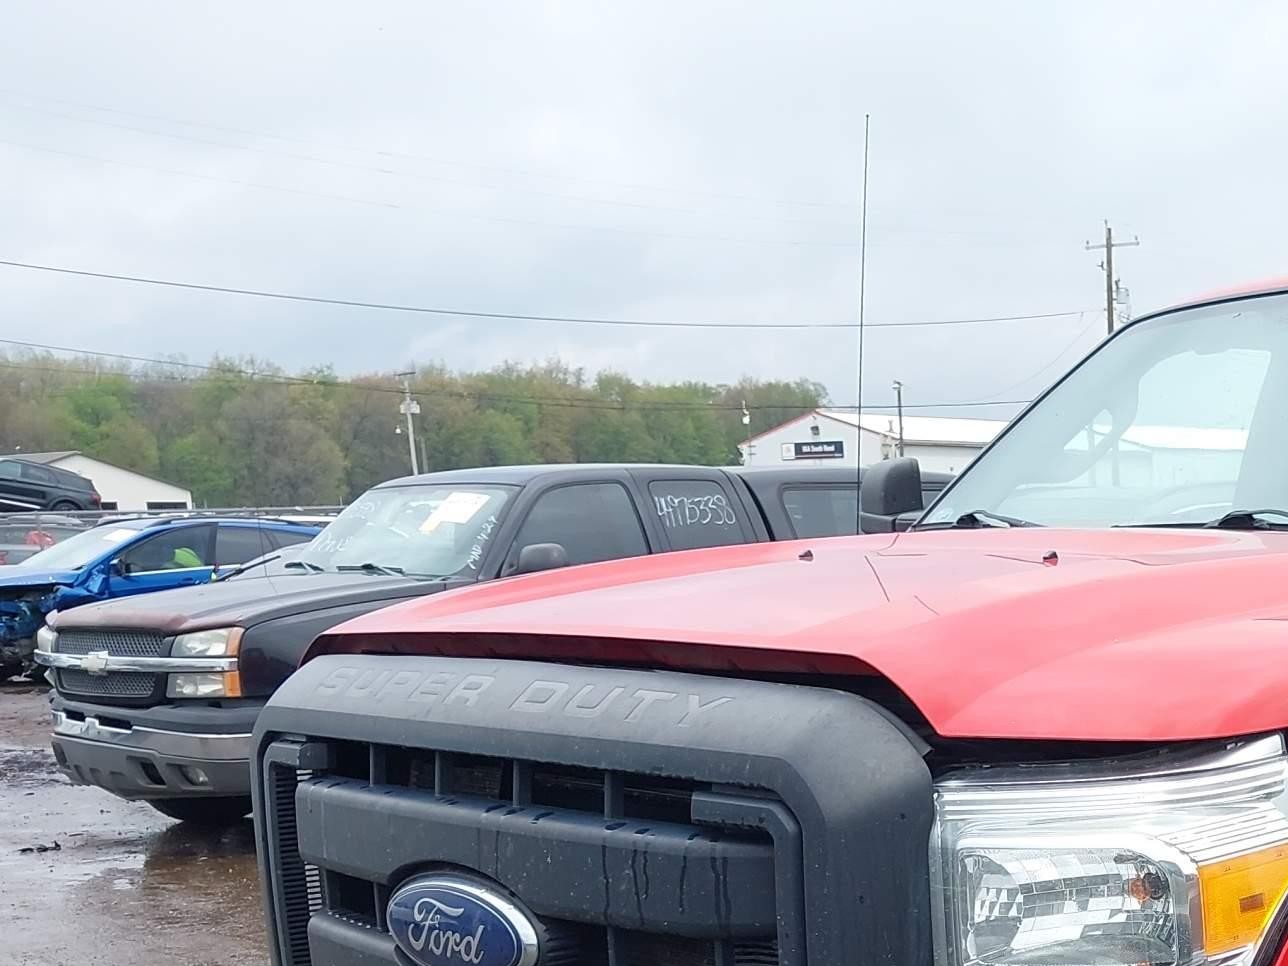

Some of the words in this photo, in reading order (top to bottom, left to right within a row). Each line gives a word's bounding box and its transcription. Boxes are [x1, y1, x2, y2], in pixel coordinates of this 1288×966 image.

[316, 665, 496, 705] SUPER
[508, 679, 735, 728] DUTY
[408, 897, 485, 964] Ford
